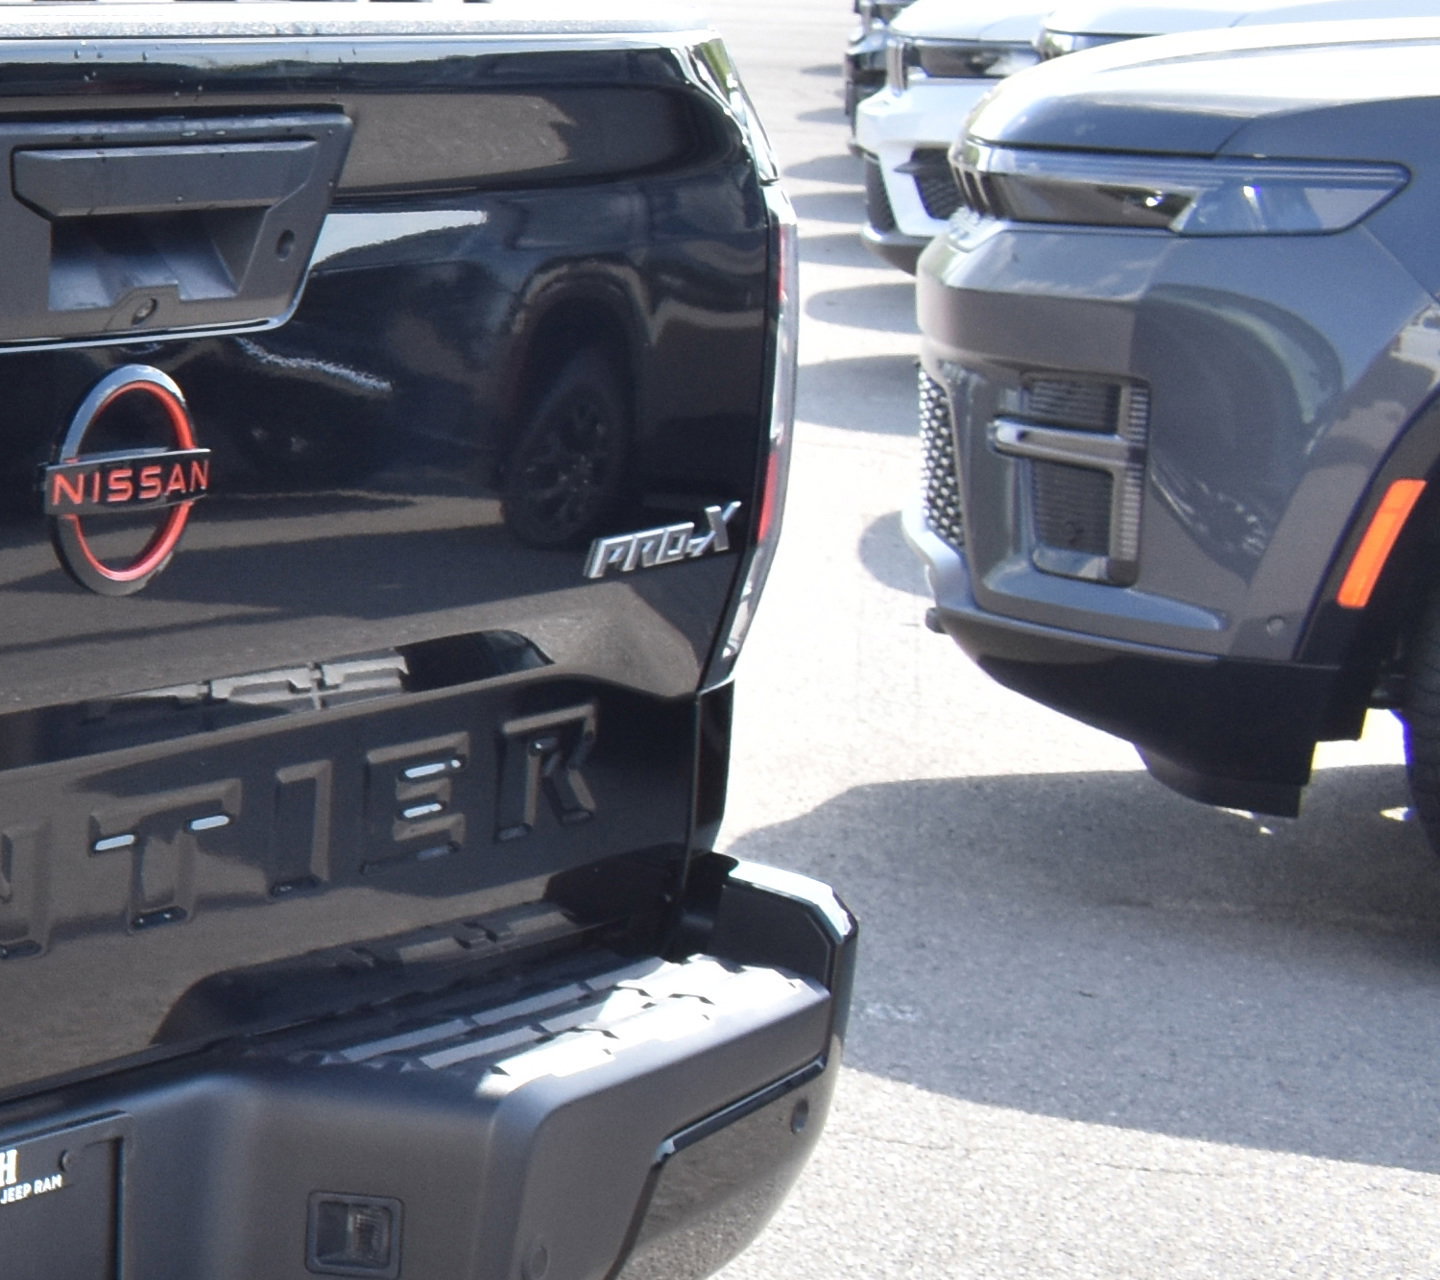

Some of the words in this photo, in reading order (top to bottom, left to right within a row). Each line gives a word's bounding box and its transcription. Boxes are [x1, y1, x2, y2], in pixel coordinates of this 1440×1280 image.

[51, 459, 210, 506] NISSAN
[0, 1181, 32, 1205] JEEP
[34, 1173, 63, 1195] RAM
